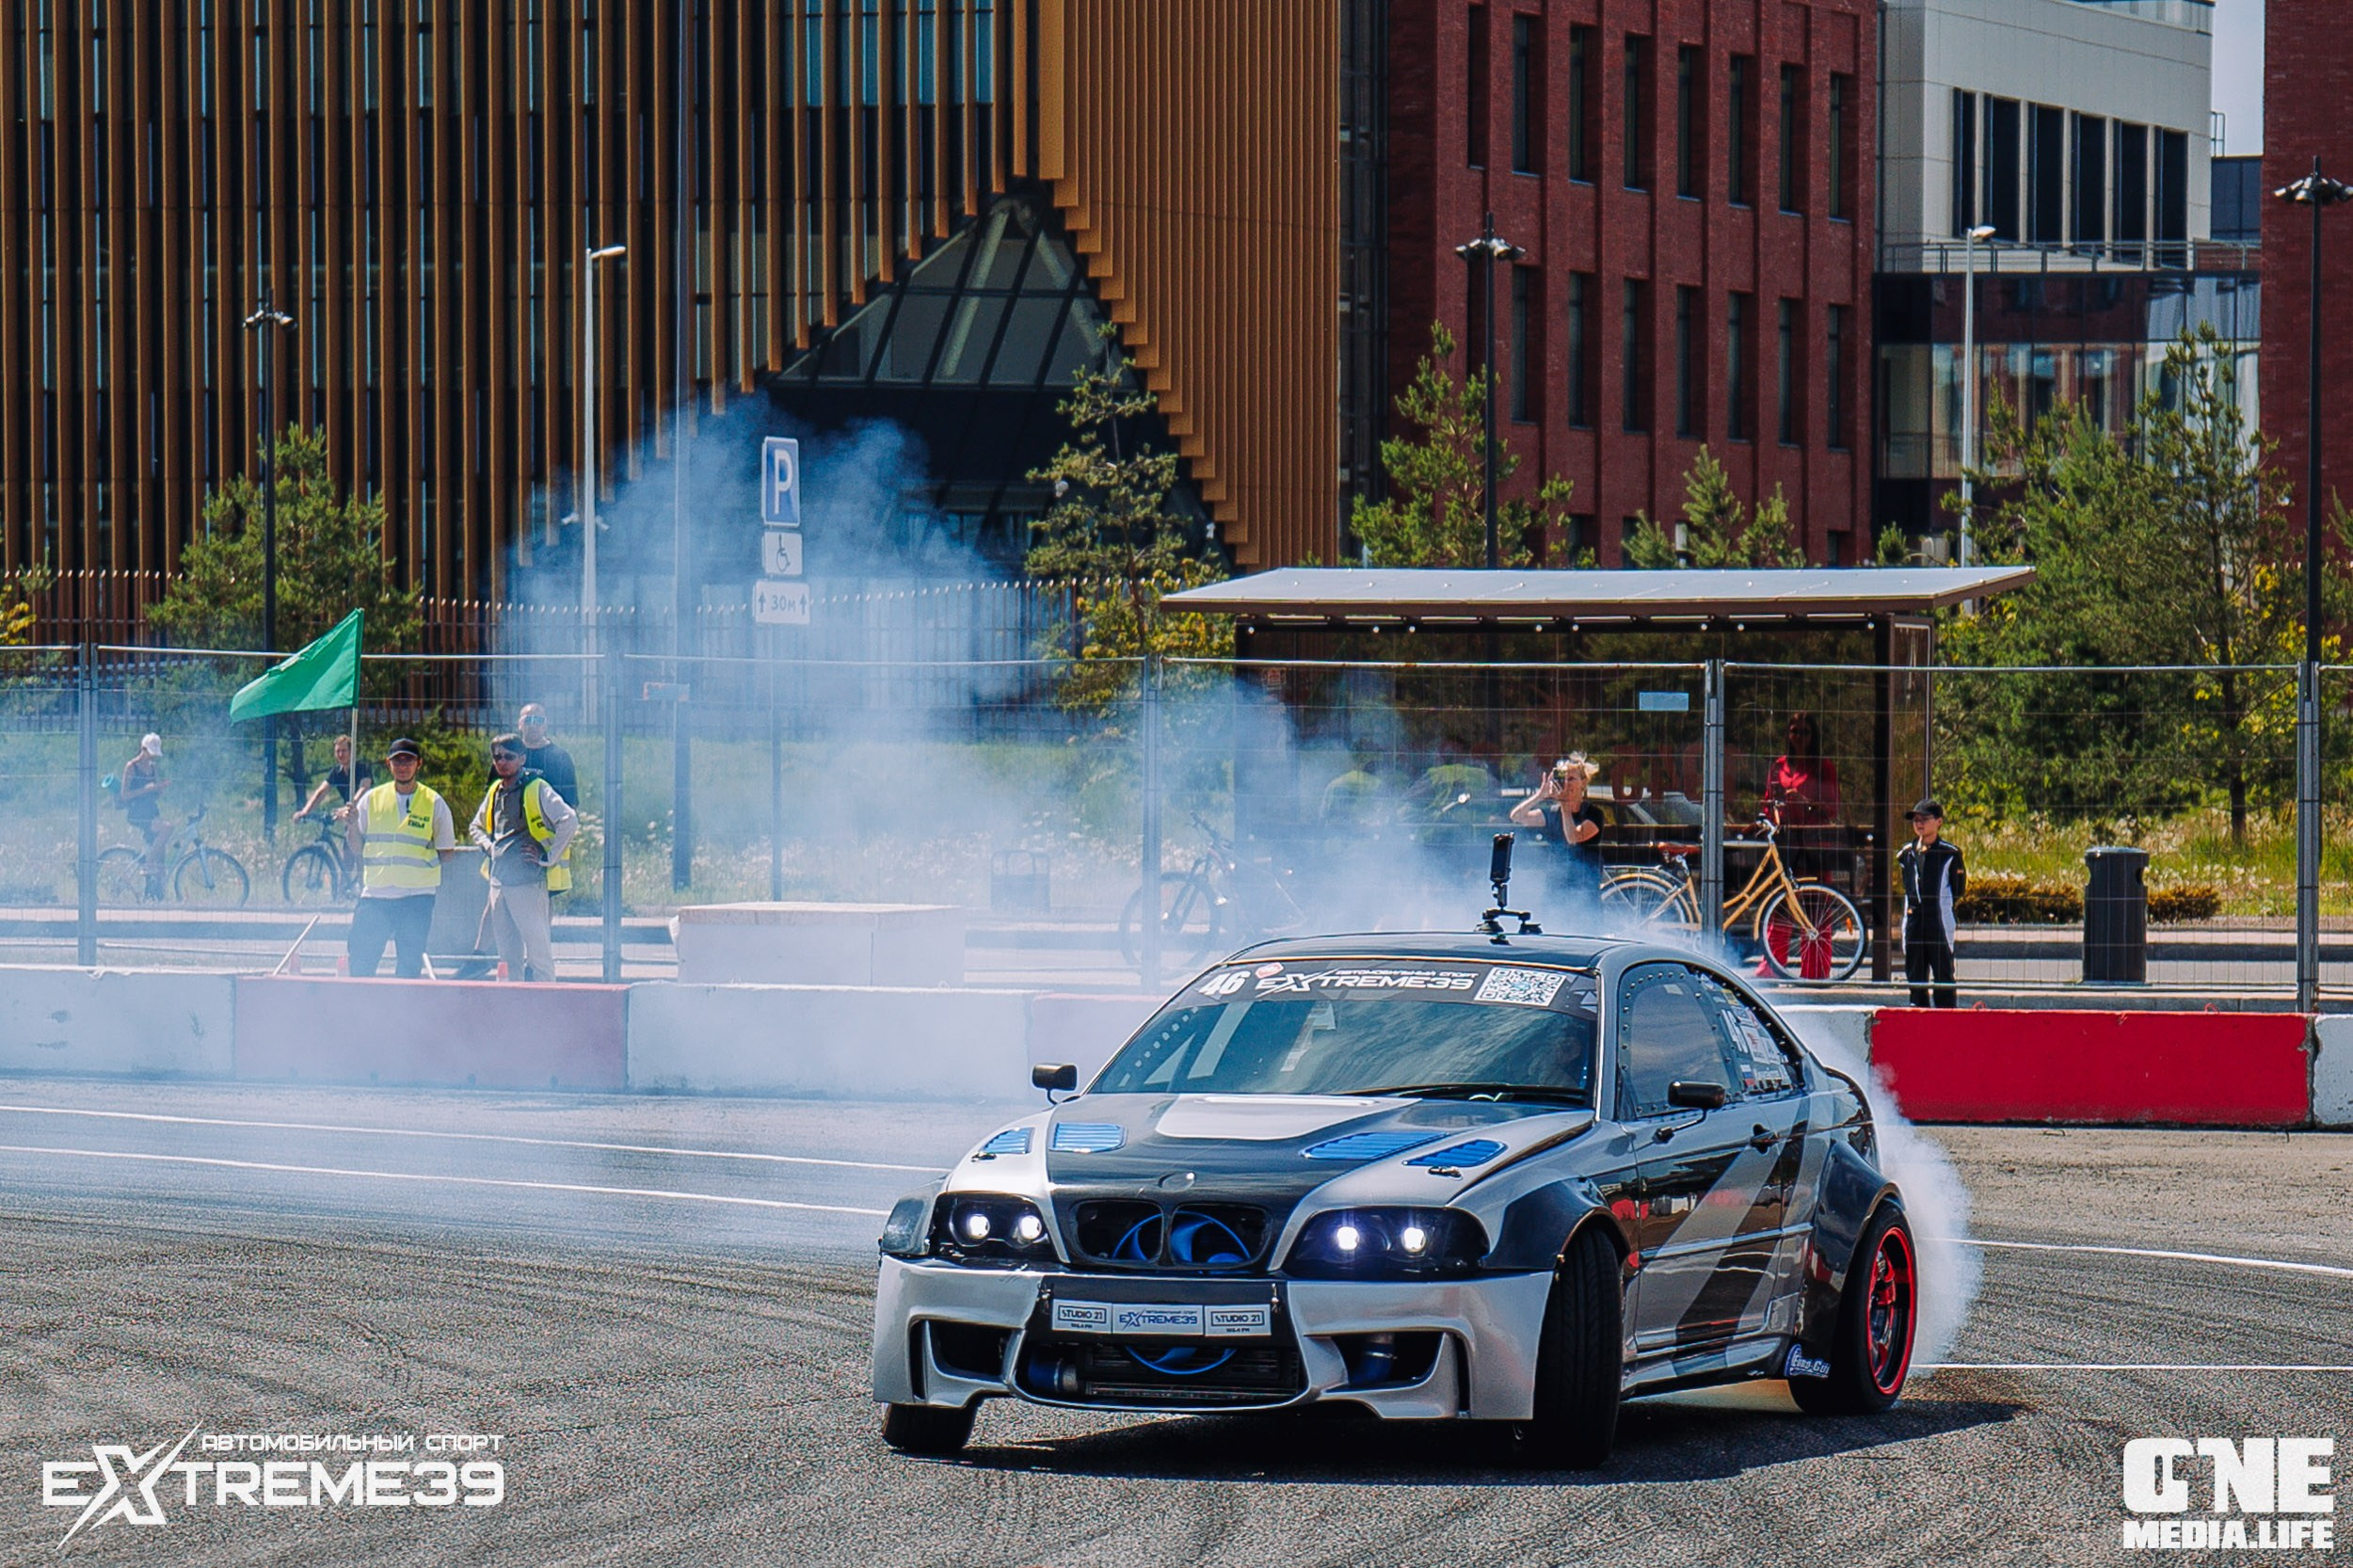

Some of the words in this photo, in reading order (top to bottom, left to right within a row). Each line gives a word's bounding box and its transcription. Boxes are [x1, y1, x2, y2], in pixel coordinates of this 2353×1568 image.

[774, 448, 793, 515] P
[1198, 970, 1251, 996] 46
[1062, 1308, 1092, 1320] STUDIO
[1094, 1310, 1103, 1320] 21
[1215, 1314, 1249, 1323] STUDIO
[1251, 1314, 1260, 1322] 21
